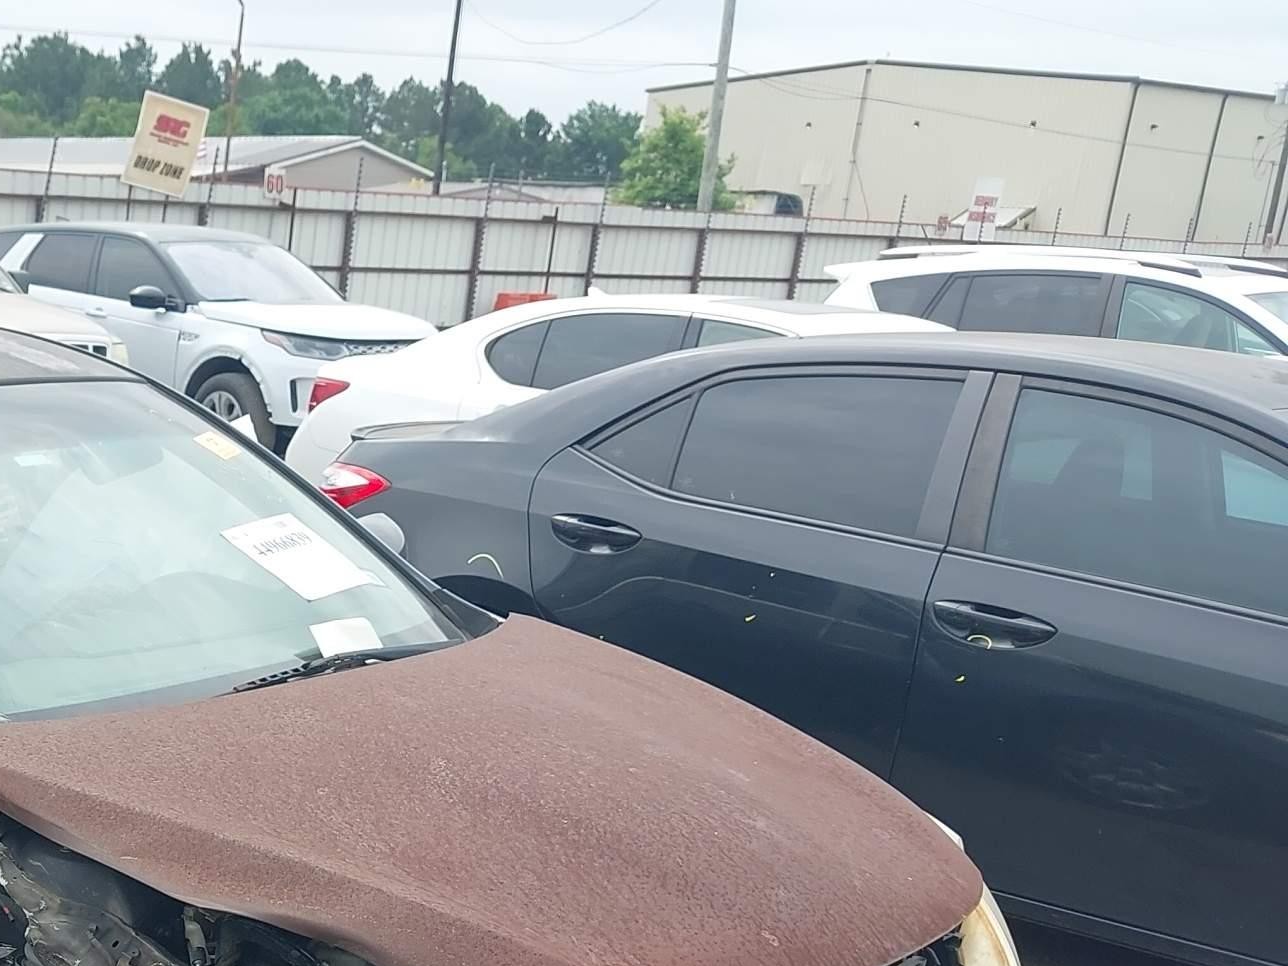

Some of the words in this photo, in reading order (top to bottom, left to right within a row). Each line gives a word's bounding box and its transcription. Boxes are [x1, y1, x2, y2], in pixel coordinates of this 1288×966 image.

[133, 155, 161, 173] DROP
[159, 162, 185, 180] ZONE
[267, 174, 283, 193] 60
